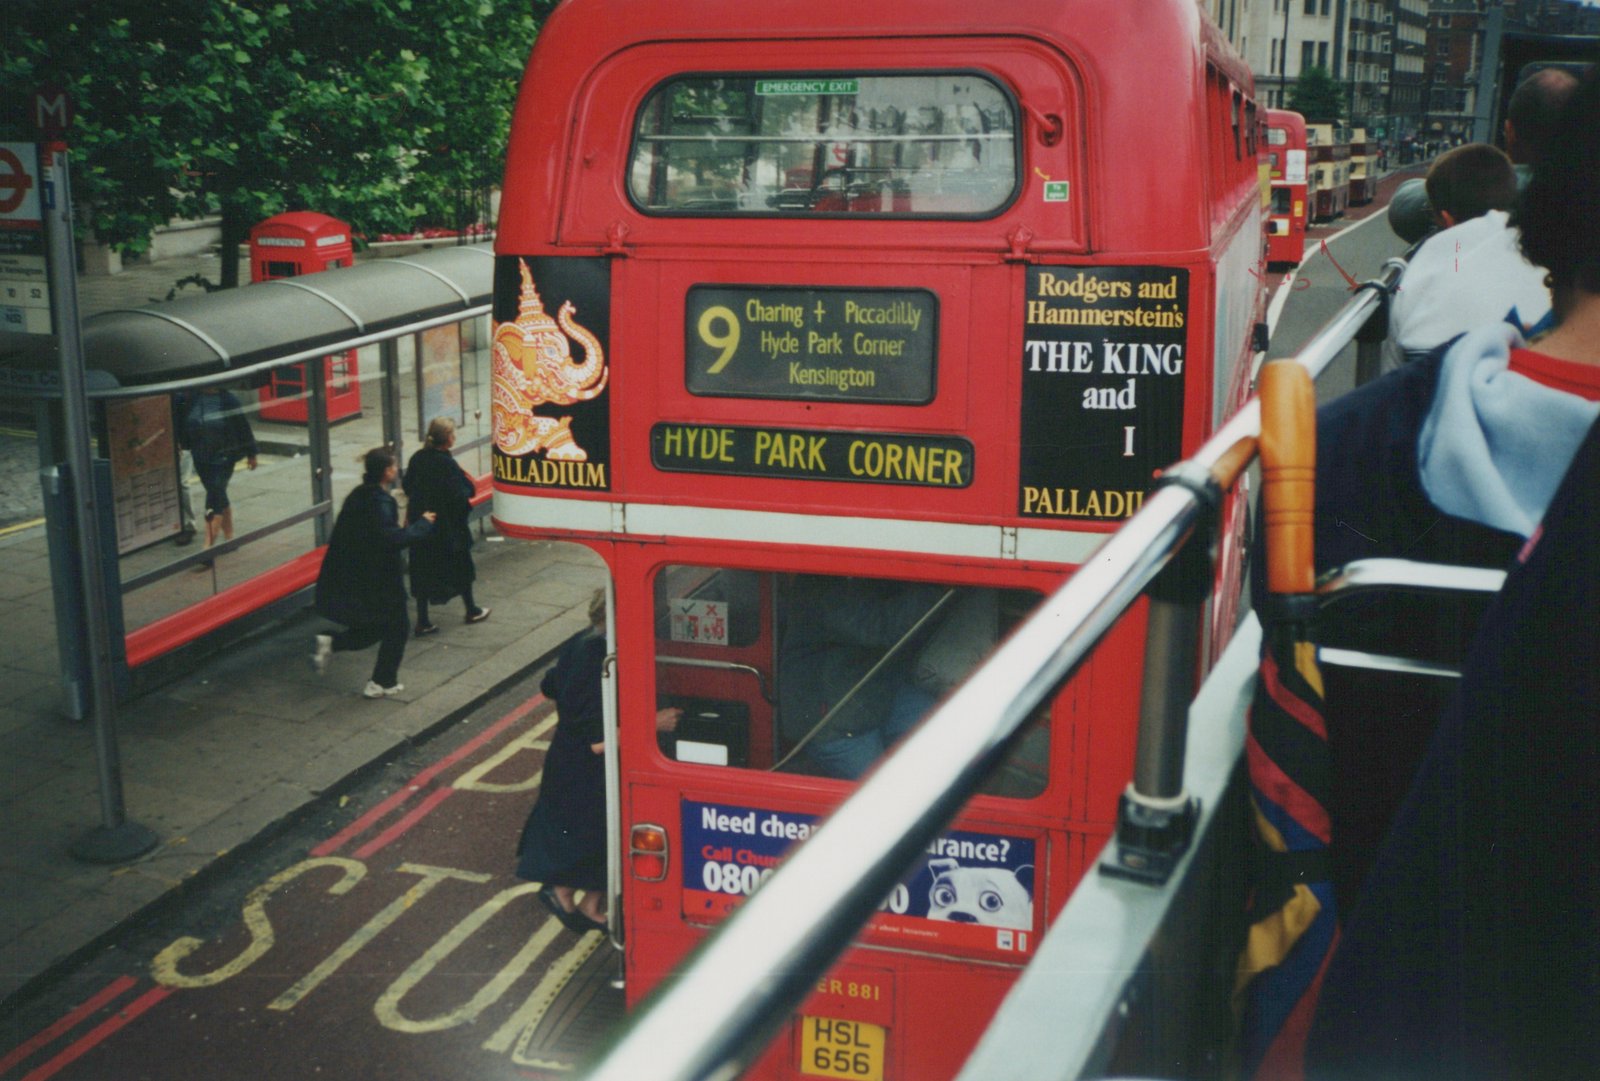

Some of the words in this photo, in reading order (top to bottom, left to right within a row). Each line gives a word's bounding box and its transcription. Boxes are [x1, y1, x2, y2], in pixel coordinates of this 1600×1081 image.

[762, 82, 826, 92] EMERGENCY
[829, 82, 853, 92] EXIT
[36, 94, 67, 128] M
[1038, 272, 1132, 303] Rodgers
[1137, 275, 1177, 299] and
[746, 299, 804, 327] Charing
[845, 301, 922, 331] Piccadilly
[1027, 300, 1185, 328] Hammerstein's
[697, 305, 741, 373] 9
[761, 331, 799, 359] Hyde
[808, 332, 843, 354] Park
[853, 333, 905, 356] Corner
[1025, 340, 1093, 373] THE
[1101, 342, 1183, 375] KING
[789, 362, 875, 391] Kensington
[1081, 378, 1137, 410] and
[664, 427, 735, 462] HYDE
[754, 431, 827, 471] PARK
[849, 440, 964, 484] CORNER
[1123, 426, 1136, 456] I
[493, 454, 606, 488] PALLADIUM
[702, 807, 756, 835] Need
[926, 837, 1010, 863] rance?
[702, 845, 732, 862] Call
[848, 982, 880, 1001] 881
[815, 1018, 871, 1048] HSL
[814, 1047, 870, 1075] 656
